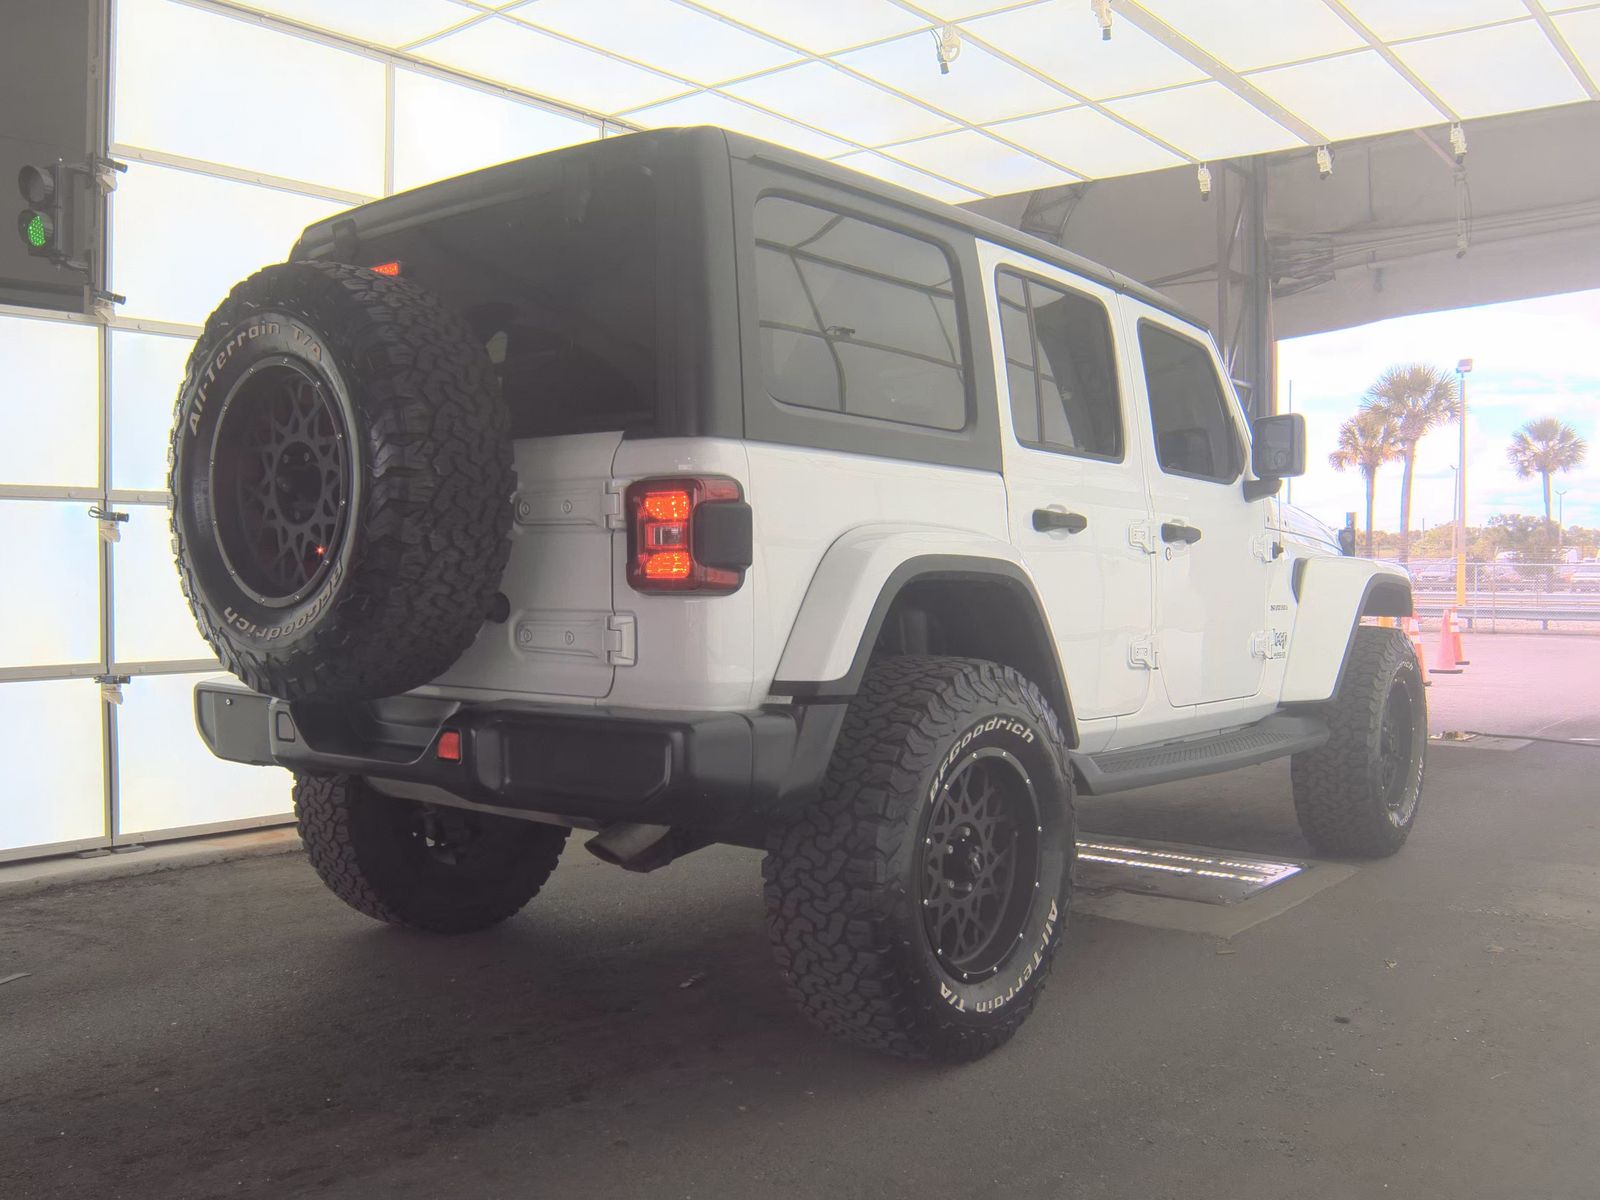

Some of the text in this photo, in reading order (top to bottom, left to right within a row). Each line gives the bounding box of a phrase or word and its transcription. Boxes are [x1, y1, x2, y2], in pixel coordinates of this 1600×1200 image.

[189, 320, 322, 437] All-Terrain T/A
[940, 898, 1058, 1014] All-Terrain T/A
